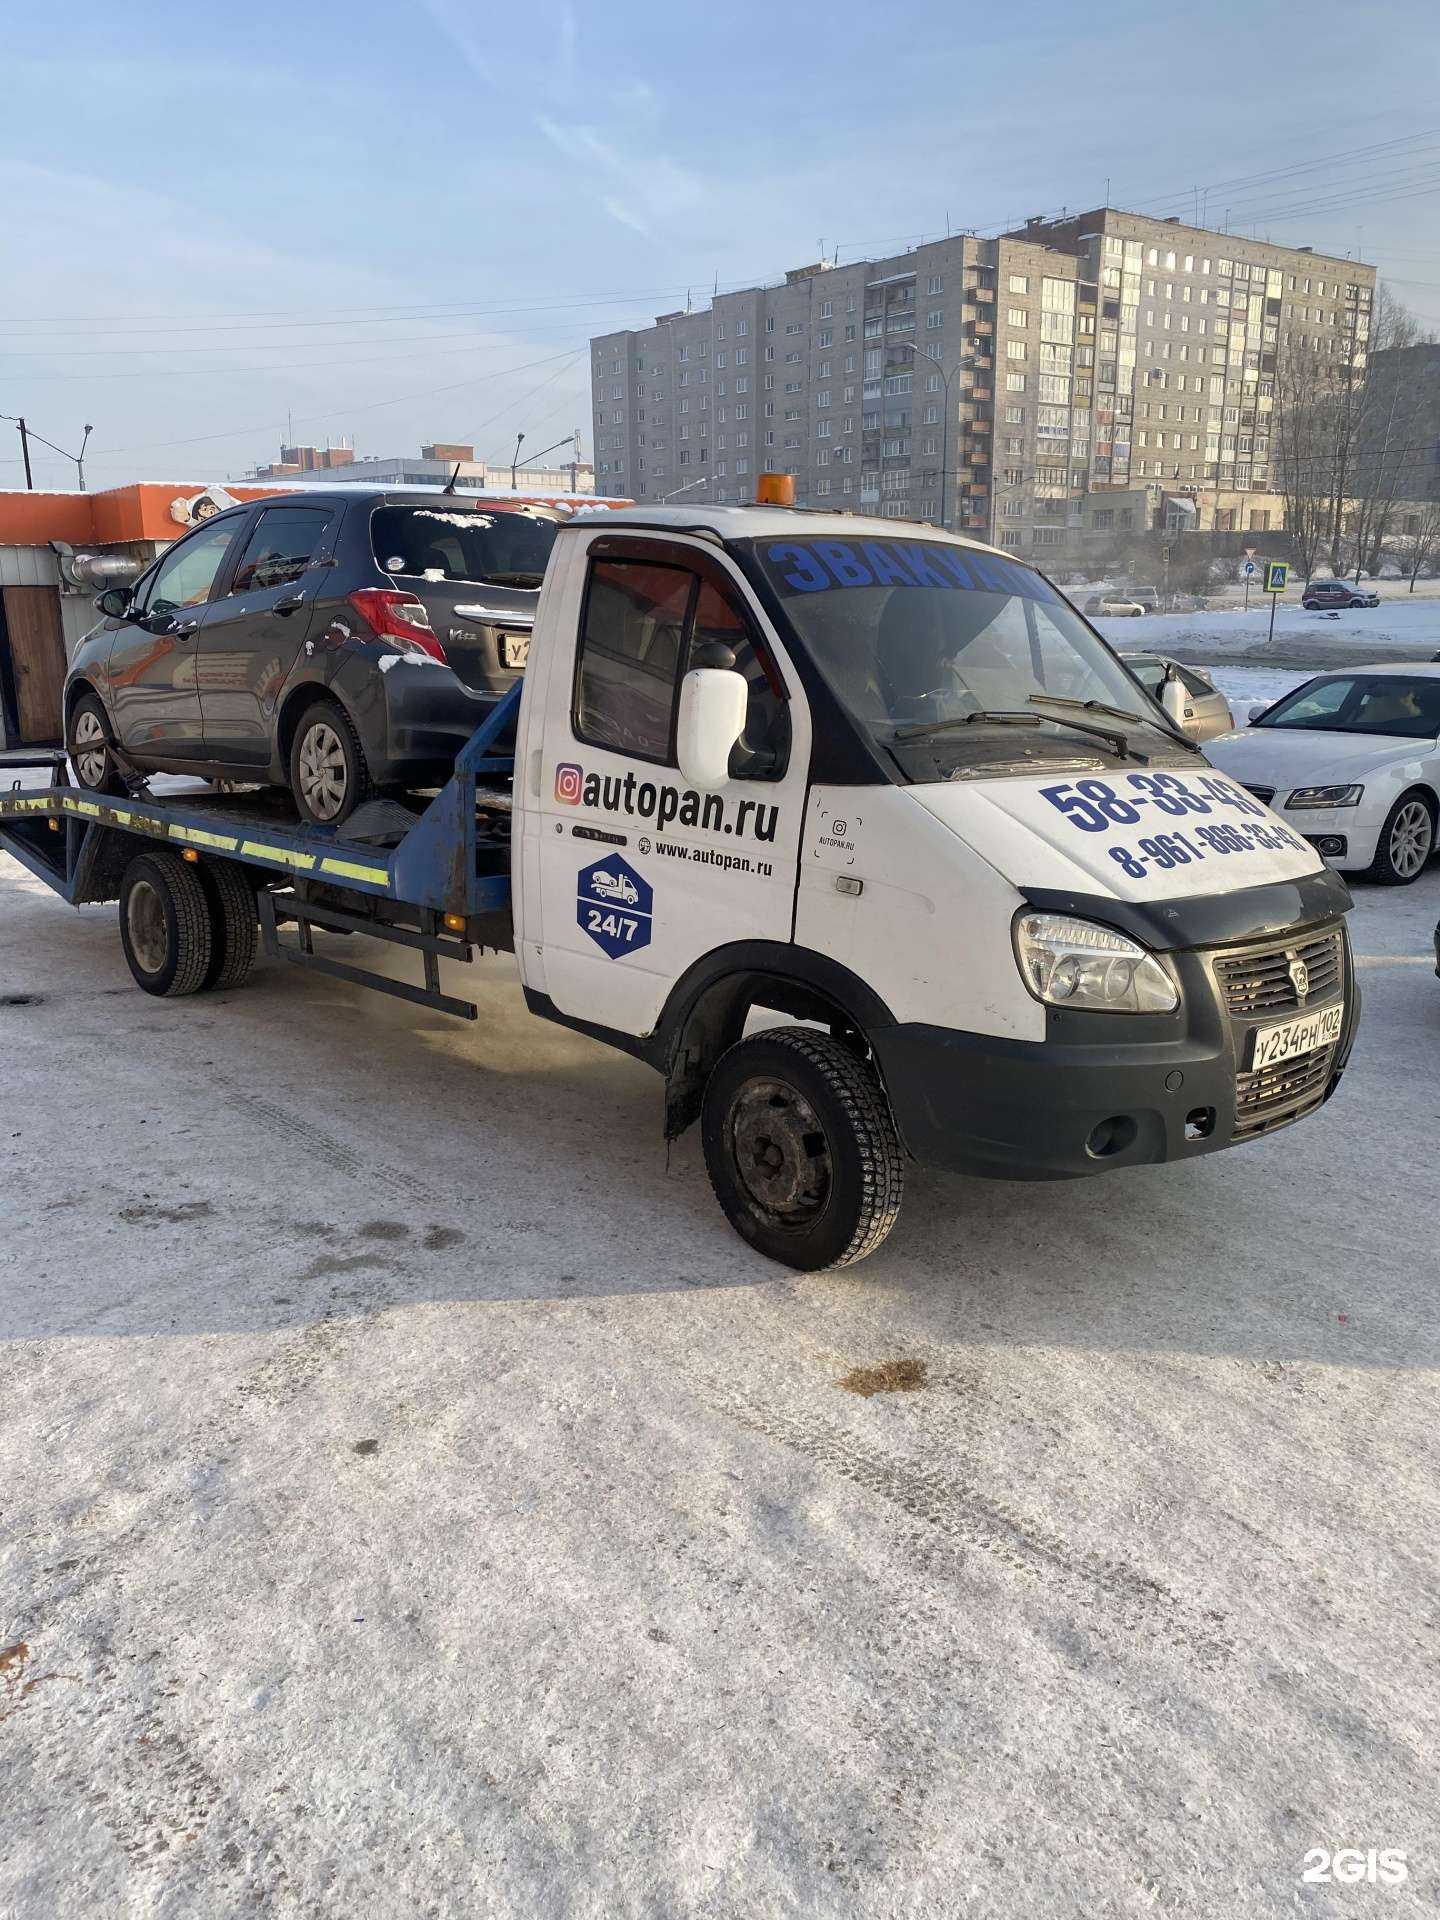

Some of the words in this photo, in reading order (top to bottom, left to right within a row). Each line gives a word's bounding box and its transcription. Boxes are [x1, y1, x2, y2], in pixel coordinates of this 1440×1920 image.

[767, 542, 1060, 603] ЭВАКУА
[582, 771, 780, 843] autopan.ru
[1038, 773, 1267, 832] 58-33-43
[655, 842, 773, 877] www.autopan.ru
[819, 836, 855, 851] AUTOPAN.RU
[1108, 823, 1308, 879] 8-961-866-33-43
[587, 909, 639, 941] 24/7
[1320, 1008, 1340, 1034] 102
